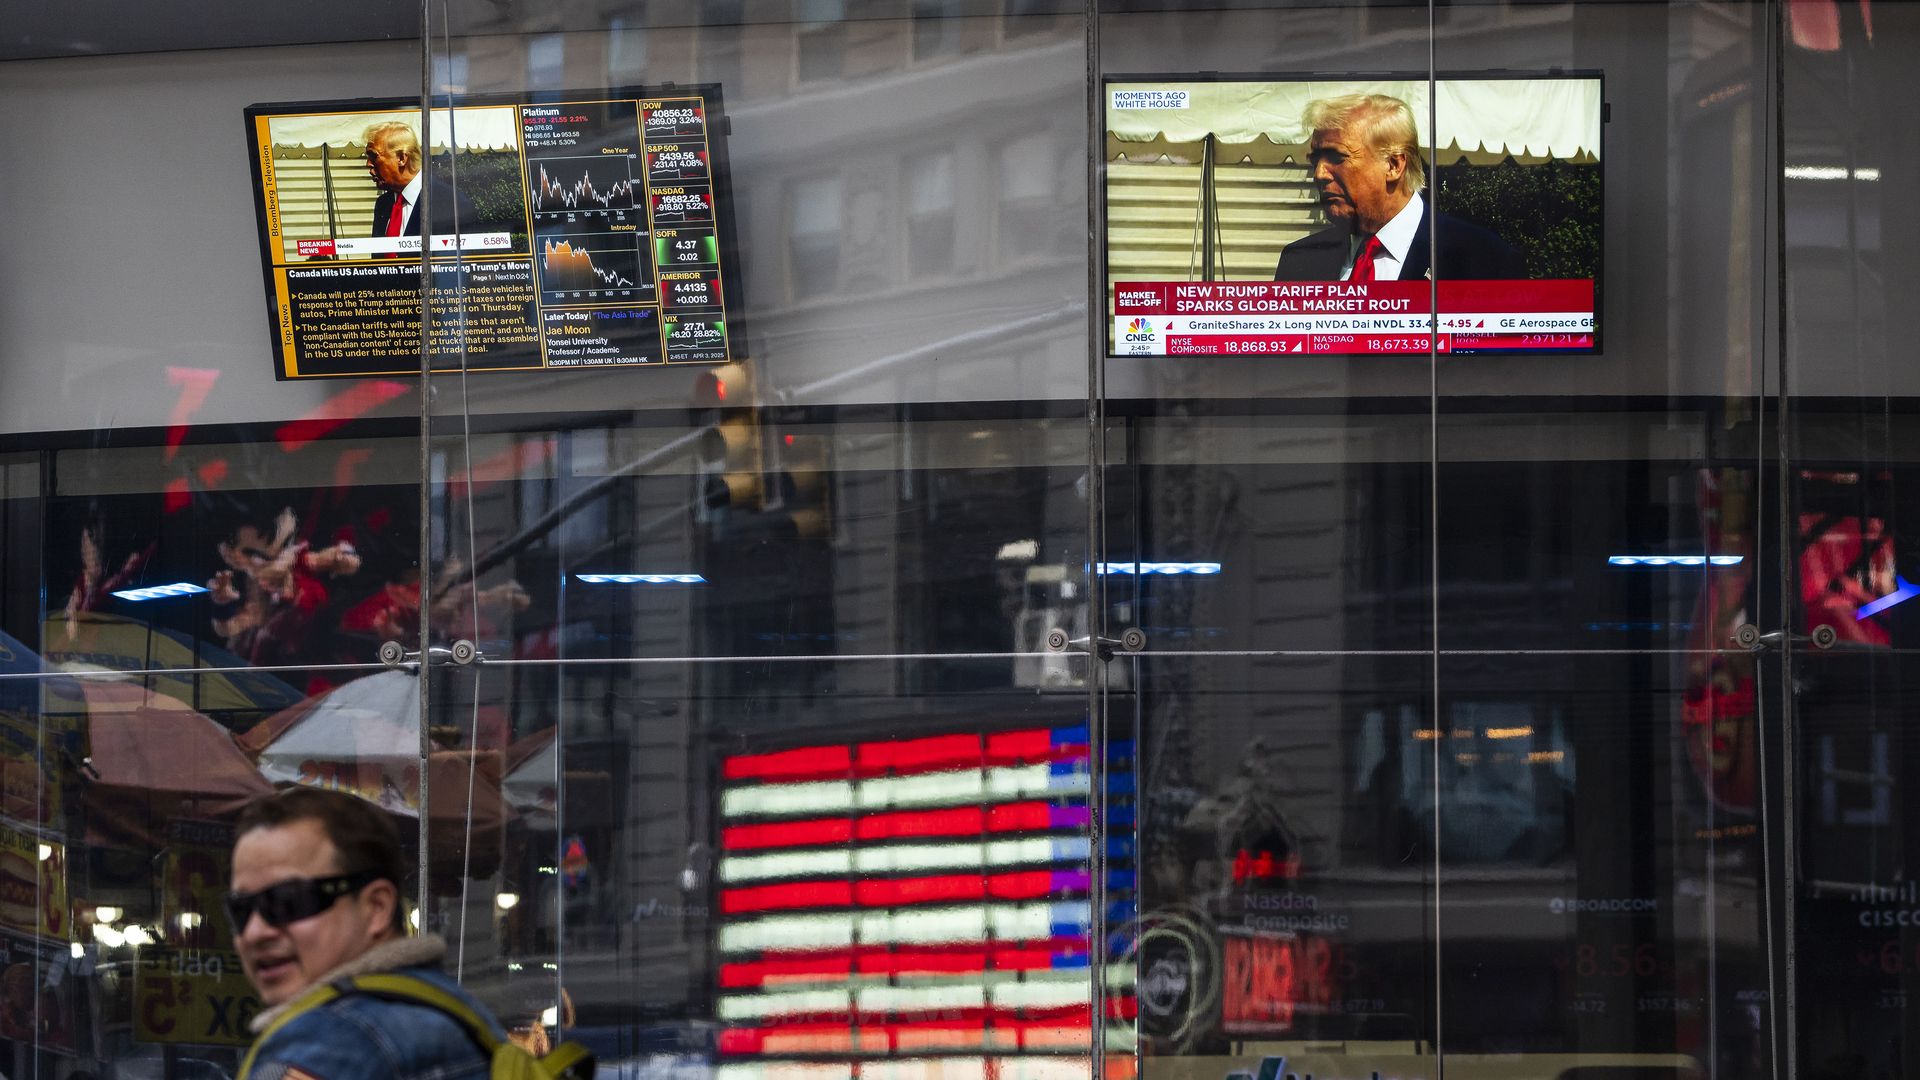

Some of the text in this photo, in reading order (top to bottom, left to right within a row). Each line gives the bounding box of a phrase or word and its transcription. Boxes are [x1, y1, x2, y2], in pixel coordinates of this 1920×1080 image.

[1115, 92, 1186, 100] MOMENTS AGO
[643, 102, 661, 110] DOW
[1115, 100, 1182, 108] WHITE HOUSE
[522, 108, 559, 117] Platinum
[652, 109, 693, 118] 40856.23
[645, 116, 702, 126] -1369.09 3.24%
[647, 144, 678, 153] S&P 500
[659, 151, 694, 161] 5439.56
[652, 159, 703, 169] -231.41 4.08%
[263, 144, 279, 237] Bloomberg Television
[651, 187, 684, 195] NASDAQ
[661, 194, 700, 204] 16682.25
[656, 202, 708, 211] -918.80 5.22%
[656, 230, 677, 238] SOFR
[299, 240, 332, 248] BREAKING
[398, 240, 422, 248] 103.15
[483, 236, 509, 246] 6.58%
[675, 240, 697, 250] 4.37
[677, 252, 698, 262] -0.02
[289, 261, 530, 278] Canada Hits US Autos With Mirrorng Trump's Move
[661, 272, 700, 281] AMERIBOR
[298, 292, 326, 300] Canada
[328, 291, 341, 299] will
[343, 291, 356, 300] put
[357, 290, 375, 298] 25%
[376, 289, 416, 298] retaliatory
[492, 285, 524, 293] vehicles
[525, 284, 533, 292] in
[674, 283, 707, 292] 4.4135
[1176, 285, 1368, 298] NEW TRUMP TARIFF PLAN
[676, 295, 708, 304] +0.0013
[1119, 291, 1156, 299] MARKET
[299, 301, 333, 310] response
[358, 299, 383, 308] Trump
[507, 294, 534, 303] foreign
[1119, 299, 1161, 307] SELL-OFF
[1176, 298, 1411, 312] SPARKS GLOBAL MARKET ROUT
[300, 310, 326, 318] autos,
[328, 309, 353, 317] Prime
[355, 308, 389, 316] Minister
[391, 307, 413, 315] Mark
[481, 303, 524, 312] Thursday.
[592, 310, 651, 319] "The Asia Trade"
[544, 312, 588, 321] Later Today
[282, 304, 293, 347] Top News
[302, 323, 318, 332] The
[320, 322, 360, 331] Canadian
[362, 321, 388, 330] tariffs
[390, 320, 404, 329] will
[480, 317, 498, 325] that
[500, 316, 525, 324] aren't
[683, 322, 705, 331] 27.71
[1189, 320, 1265, 330] GraniteShares
[1268, 320, 1281, 330] 2x
[1284, 320, 1312, 331] Long
[1315, 319, 1349, 329] NVDA
[1352, 319, 1370, 329] Dai
[1373, 319, 1405, 329] NVDL
[1442, 319, 1472, 328] -4.95
[1499, 319, 1516, 328] GE
[1519, 318, 1577, 329] Aerospace
[302, 333, 340, 342] compliant
[341, 332, 358, 340] with
[360, 331, 373, 339] the
[450, 326, 495, 336] Ageement,
[497, 326, 511, 334] and
[524, 325, 538, 333] the
[545, 325, 591, 335] Jae Moon
[670, 329, 721, 338] +6.20 28.82%
[303, 340, 359, 350] 'non-Canadian
[360, 339, 392, 348] content'
[393, 338, 402, 346] of
[465, 336, 481, 344] that
[497, 334, 538, 343] assembled
[547, 337, 608, 347] Yonsei University
[1125, 333, 1155, 342] CNBC
[1171, 338, 1192, 346] NYSE
[1313, 335, 1354, 343] NASDAQ
[1171, 345, 1218, 353] COMPOSITE
[1224, 341, 1287, 353] 18,868.93
[1367, 339, 1430, 351] 18,673.39
[304, 350, 313, 359] in
[315, 350, 329, 358] the
[330, 350, 343, 358] US
[345, 349, 370, 357] under
[372, 348, 386, 357] the
[388, 348, 409, 356] rules
[412, 347, 422, 355] of
[547, 347, 620, 356] Professor Academic
[1243, 891, 1318, 911] Nasdaq
[1566, 898, 1657, 912] BROADCOM
[1243, 912, 1349, 931] Composite
